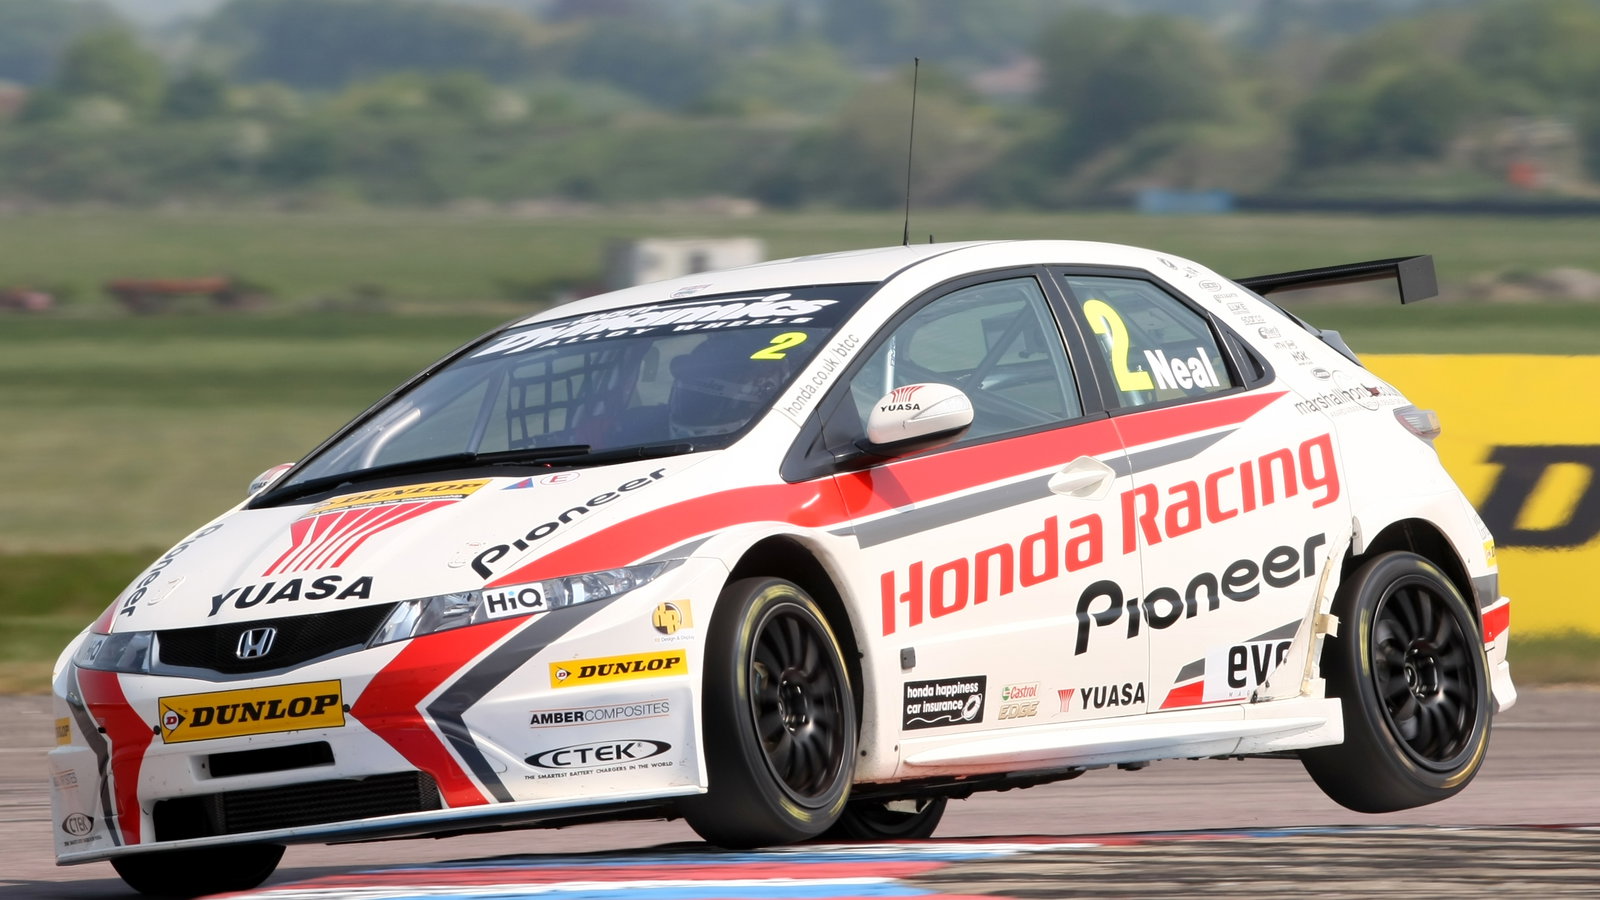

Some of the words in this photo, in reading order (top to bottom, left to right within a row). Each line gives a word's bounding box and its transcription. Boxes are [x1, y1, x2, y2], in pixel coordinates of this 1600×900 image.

[672, 317, 815, 332] WHEELS
[750, 331, 808, 360] 2
[1083, 299, 1154, 391] 2
[783, 333, 860, 418] honda.co.uk/btcc
[1143, 347, 1220, 390] Neal
[880, 403, 921, 413] YUASA
[471, 467, 666, 580] Pioneer
[880, 513, 1103, 636] Honda
[1120, 432, 1340, 555] Racing
[120, 524, 225, 617] Pioneer
[207, 574, 374, 617] YUASA
[486, 587, 543, 613] HiQ
[1074, 532, 1326, 656] Pioneer
[578, 657, 681, 678] DUNLOP
[907, 684, 934, 699] honda
[936, 682, 979, 698] happiness
[1010, 683, 1037, 699] Castrol
[1080, 682, 1146, 710] YUASA
[189, 694, 339, 727] DUNLOP
[530, 701, 670, 725] AMBERCOMPOSITES
[907, 704, 921, 714] car
[922, 700, 964, 713] insurance
[998, 701, 1040, 720] EDGE
[552, 742, 636, 767] CTEK
[538, 772, 567, 780] SMARTEST
[596, 766, 627, 774] CHARGERS
